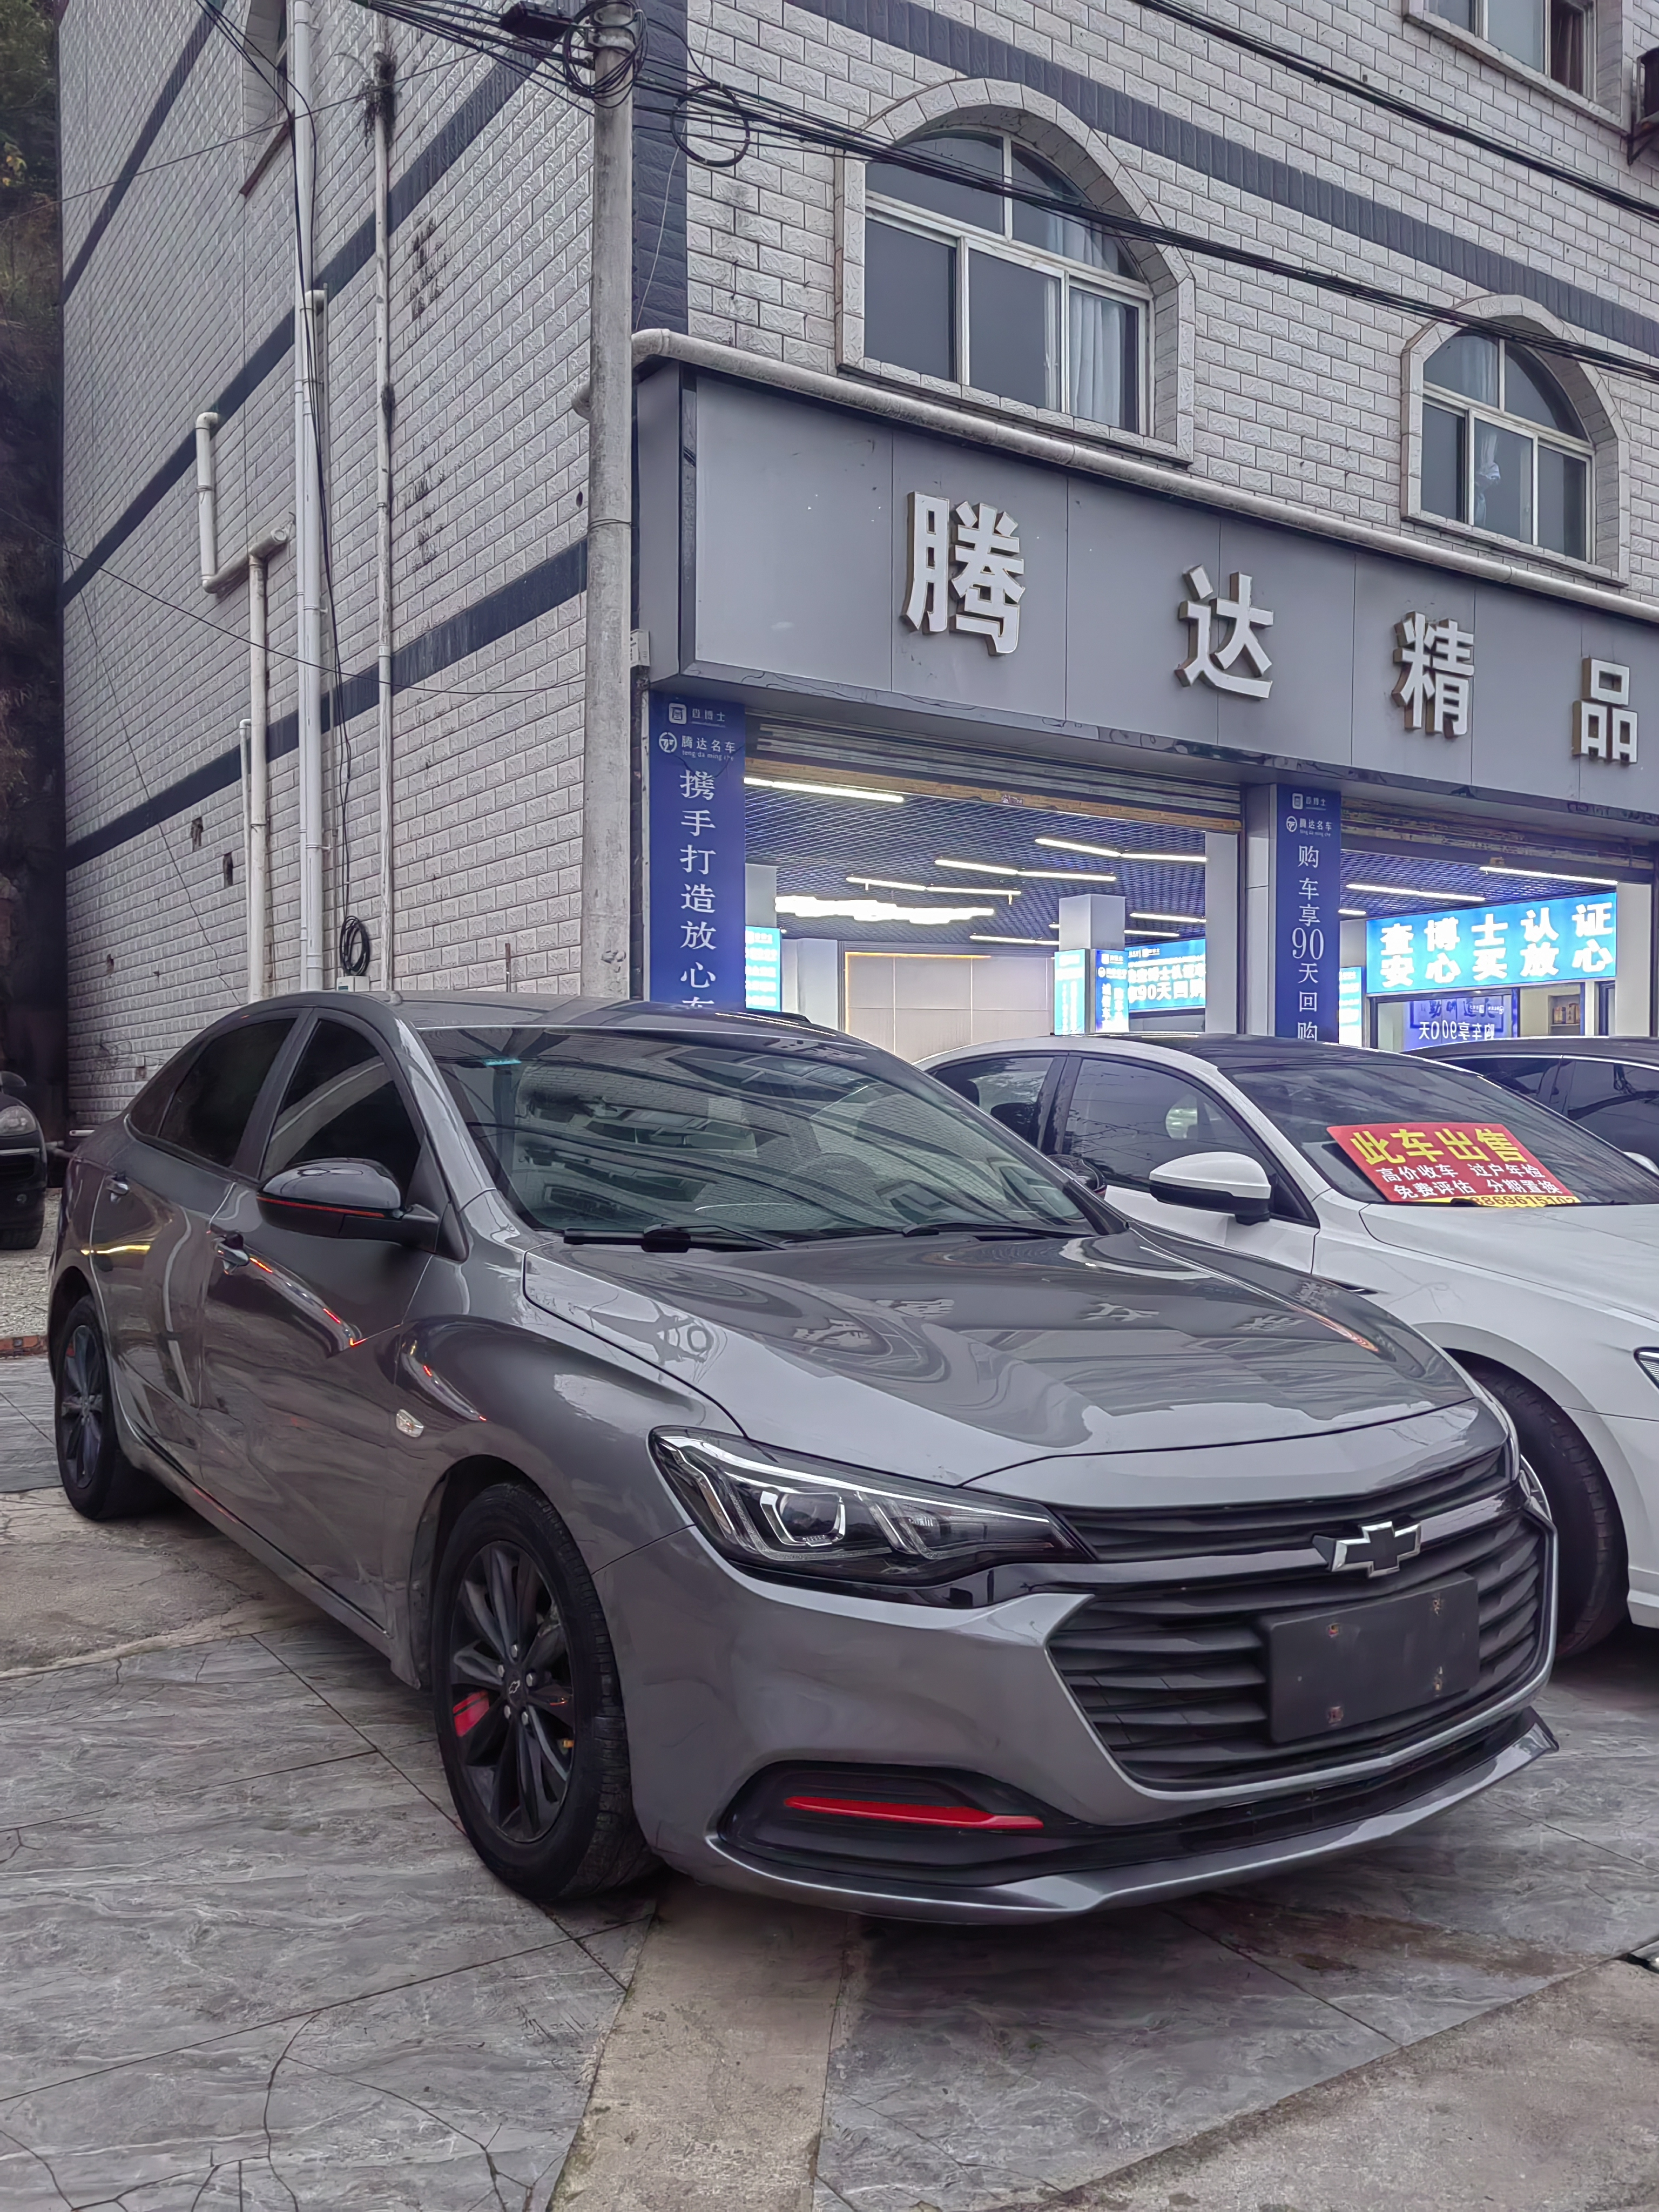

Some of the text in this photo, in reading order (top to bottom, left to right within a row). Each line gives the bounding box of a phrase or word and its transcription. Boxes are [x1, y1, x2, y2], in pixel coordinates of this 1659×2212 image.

[901, 490, 1638, 764] 腾达精品
[682, 735, 736, 754] 腾达名车
[1292, 845, 1325, 1041] 购车享90天回购
[1380, 901, 1614, 956] 查博士认证
[1380, 938, 1614, 988] 安心买放心
[1350, 1128, 1529, 1165] 此车出售
[1375, 1163, 1546, 1183] 高价收车 过户年检
[1393, 1178, 1563, 1200] 免费评估 分期置换
